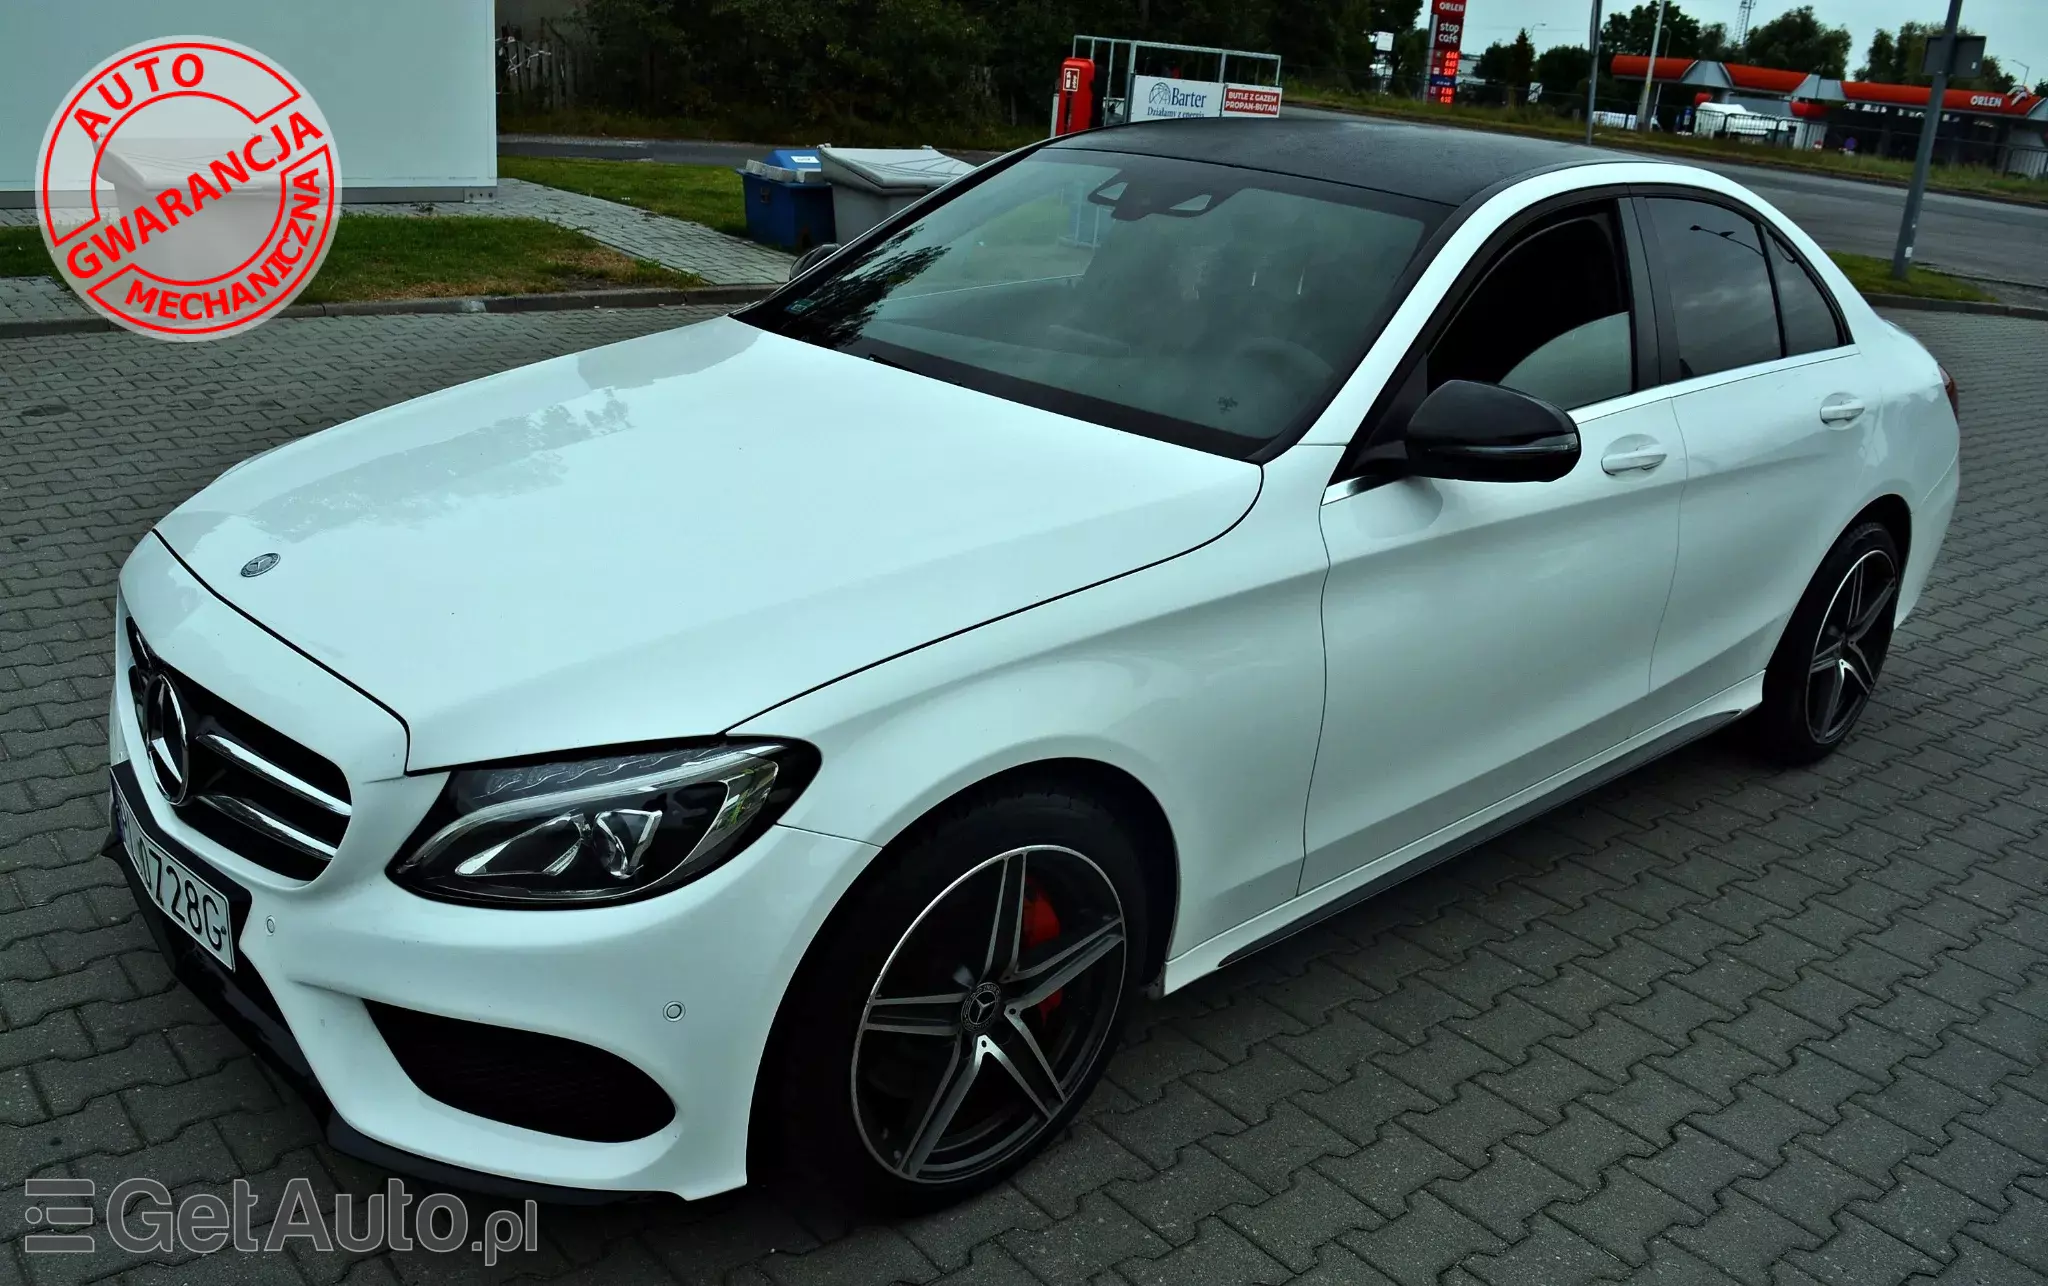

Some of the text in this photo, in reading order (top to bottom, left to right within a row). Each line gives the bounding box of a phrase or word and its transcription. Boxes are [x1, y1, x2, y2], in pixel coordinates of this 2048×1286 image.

[1439, 2, 1464, 11] ORLEN
[1440, 22, 1459, 34] stop
[1438, 33, 1458, 43] cafe
[1171, 87, 1207, 108] Barter
[1228, 91, 1277, 103] BUTLE Z GAZEM
[1970, 95, 2002, 107] ORLEN
[1225, 101, 1278, 112] PROPAN-BUTAN
